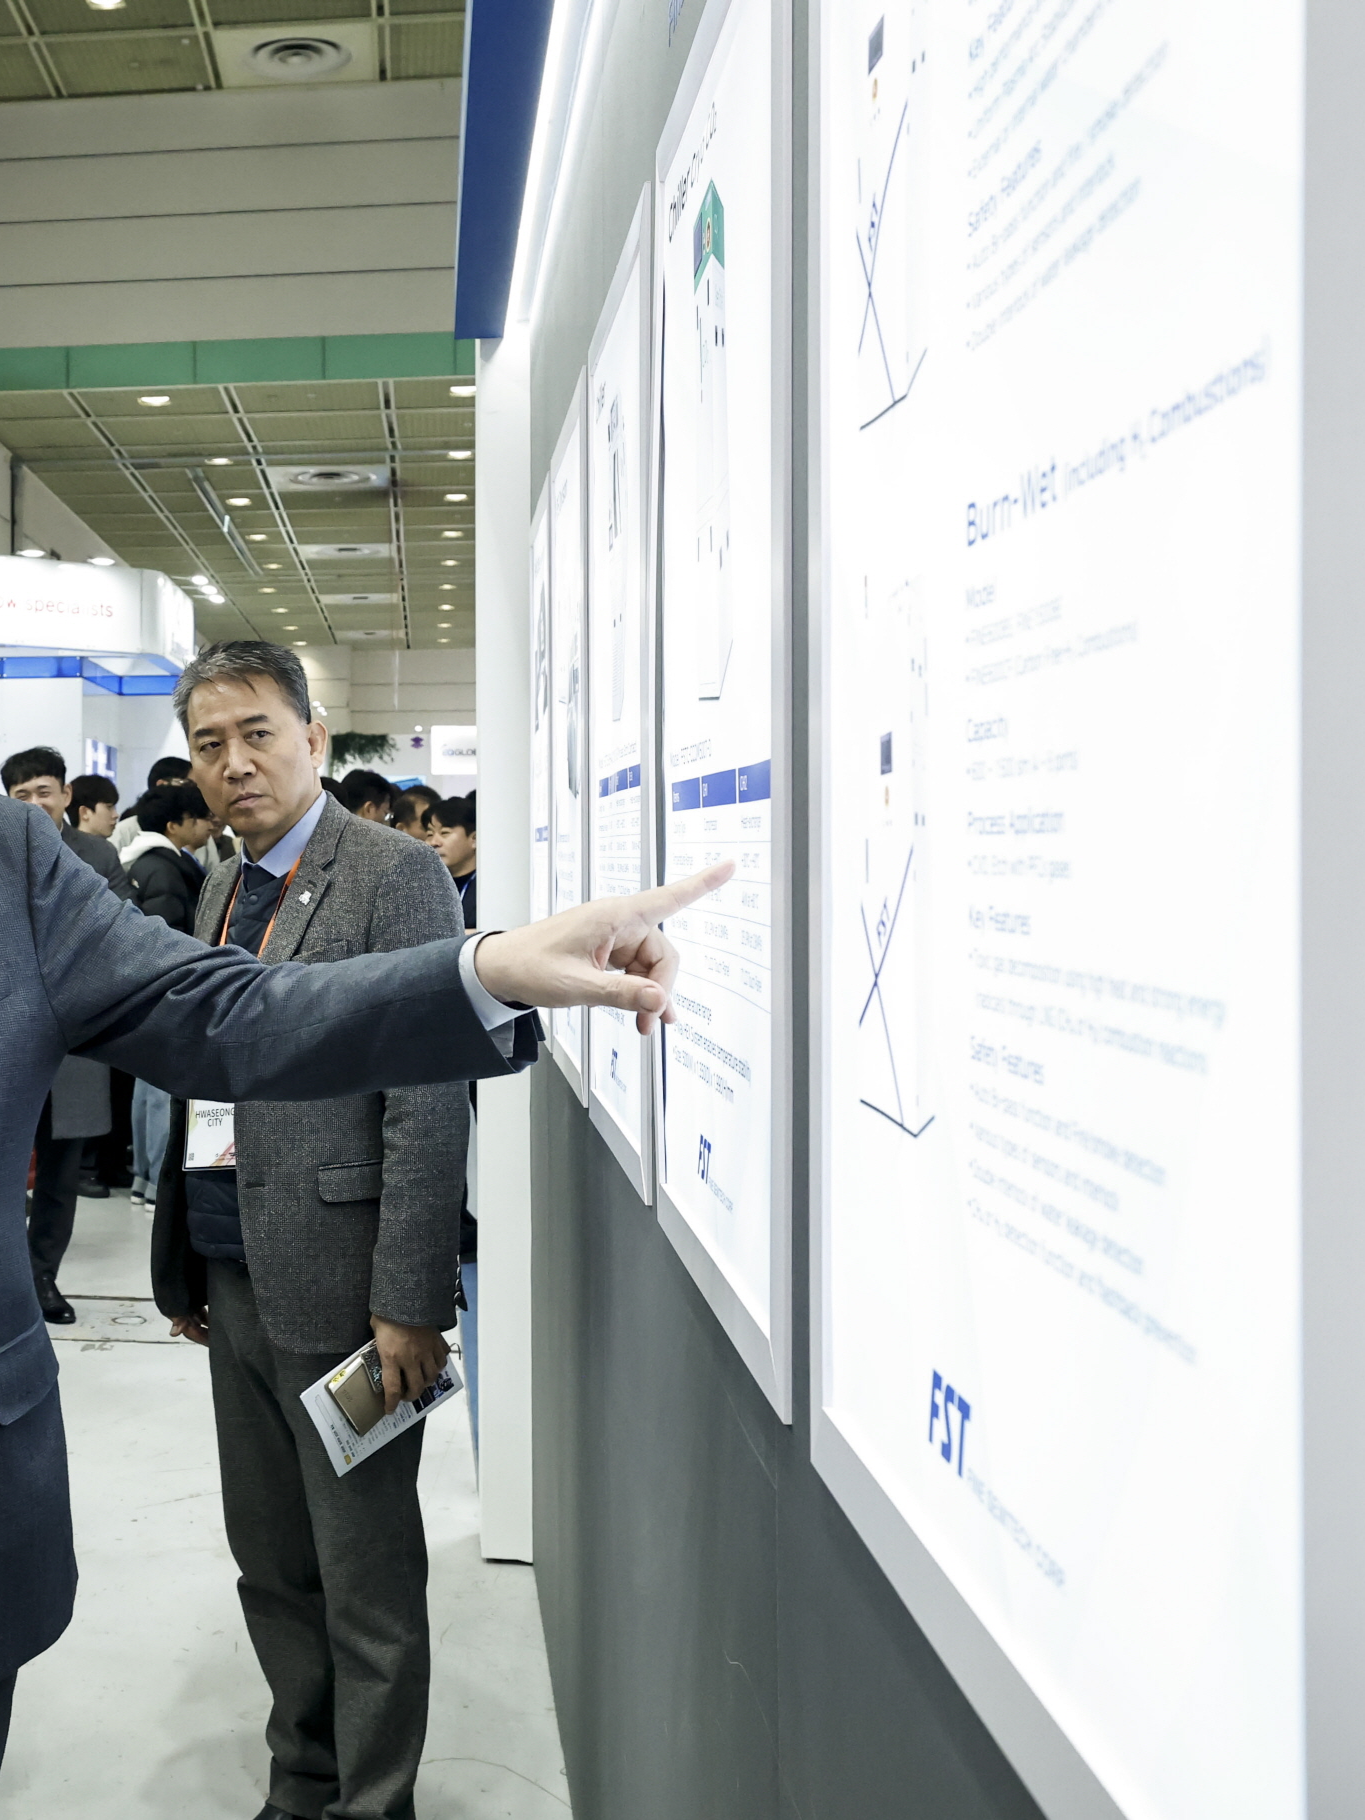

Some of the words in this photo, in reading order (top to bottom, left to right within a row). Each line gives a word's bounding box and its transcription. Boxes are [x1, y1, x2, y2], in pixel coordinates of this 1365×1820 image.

[967, 455, 1057, 547] Burn-Wet
[195, 1107, 235, 1119] HWASEONG
[207, 1118, 223, 1127] CITY
[697, 1133, 712, 1185] FST
[928, 1368, 972, 1478] FST
